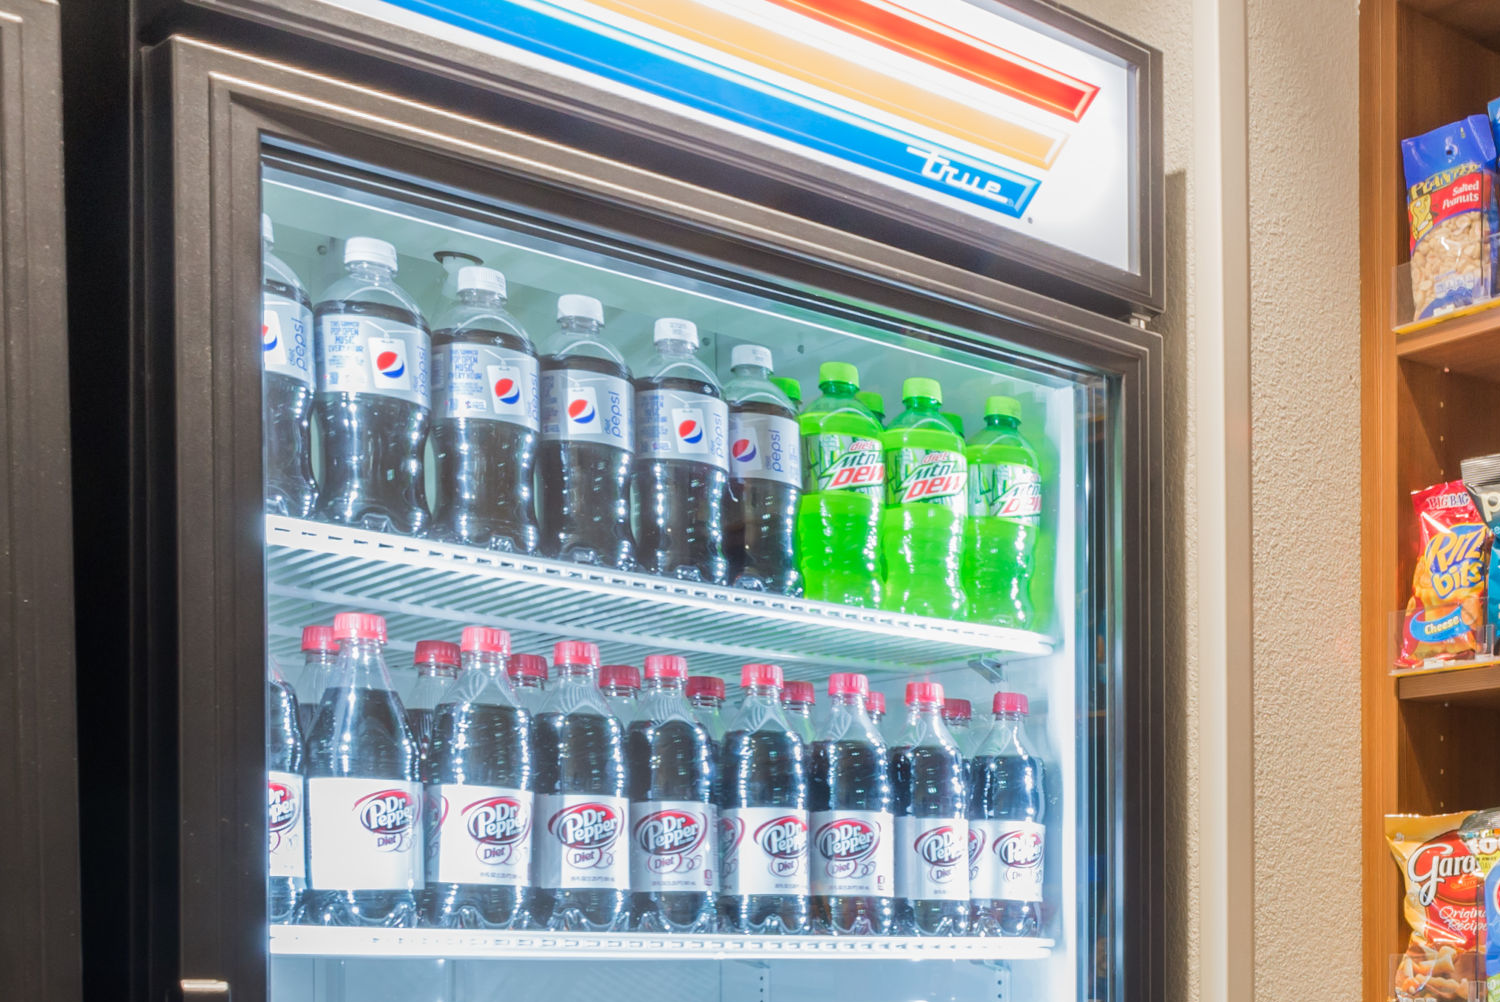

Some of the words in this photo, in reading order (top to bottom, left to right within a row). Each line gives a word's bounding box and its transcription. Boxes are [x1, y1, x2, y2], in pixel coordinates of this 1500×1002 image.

[1452, 180, 1480, 196] Salted
[1442, 192, 1480, 210] Peanuts
[291, 317, 308, 371] pepsi
[608, 390, 623, 438] pepsi
[768, 429, 784, 473] pepsi
[1427, 494, 1448, 508] BIG
[1449, 492, 1471, 507] BAG
[1427, 525, 1487, 572] RITZ
[1432, 560, 1485, 599] bits
[1424, 616, 1461, 634] Cheese
[386, 796, 405, 812] Dr
[496, 801, 517, 819] Dr
[584, 808, 605, 824] Dr
[665, 813, 686, 830] Dr
[565, 813, 618, 843] Pepper
[785, 821, 804, 836] Dr
[840, 824, 861, 839] Dr
[377, 835, 397, 847] Diet
[647, 824, 698, 850] Pepper
[823, 830, 874, 858] Pepper
[483, 847, 505, 860] Diet
[573, 850, 595, 863] Diet
[654, 856, 675, 870] Diet
[776, 861, 796, 875] Diet
[830, 861, 852, 873] Diet
